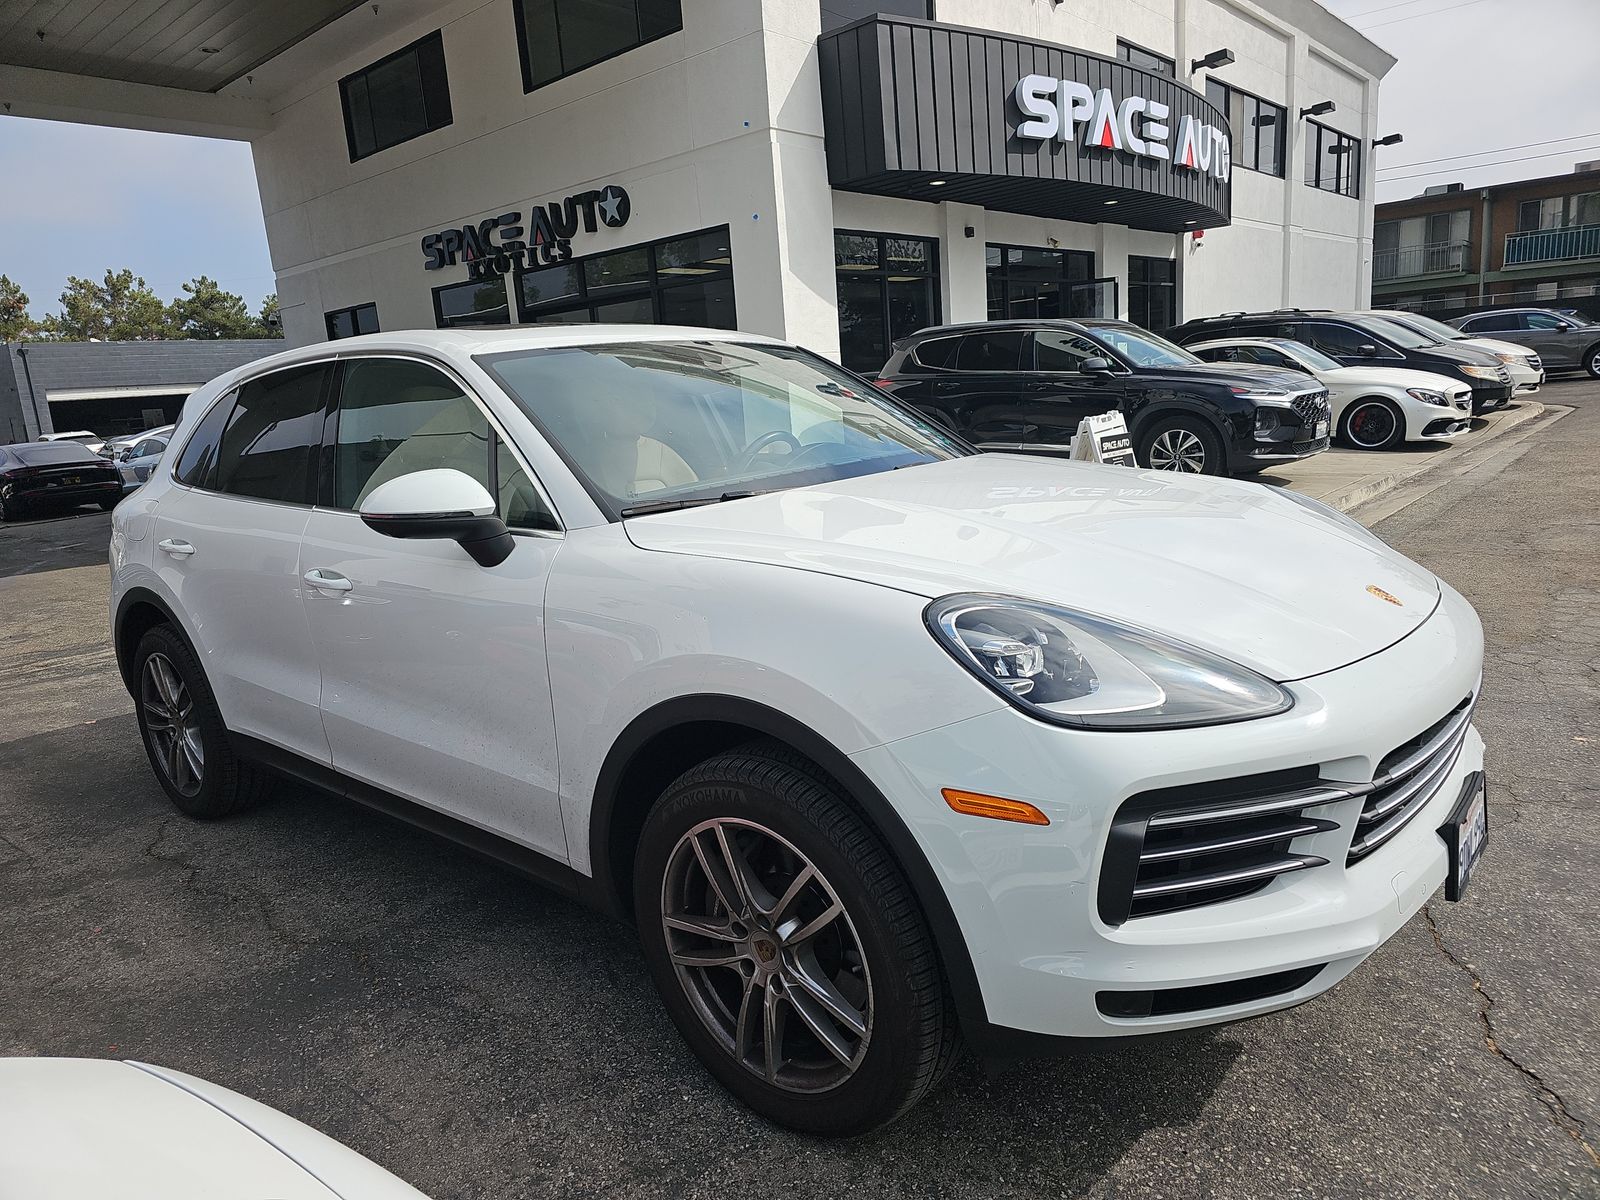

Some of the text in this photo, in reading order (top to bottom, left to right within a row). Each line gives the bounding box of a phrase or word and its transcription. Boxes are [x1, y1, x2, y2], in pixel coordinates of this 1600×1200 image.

[1015, 74, 1170, 160] SPACE
[421, 184, 631, 271] SPACE AUTO
[467, 238, 573, 281] EXOTICS
[1102, 438, 1130, 451] SPACE AUTO
[674, 787, 741, 808] YOKOHAMA
